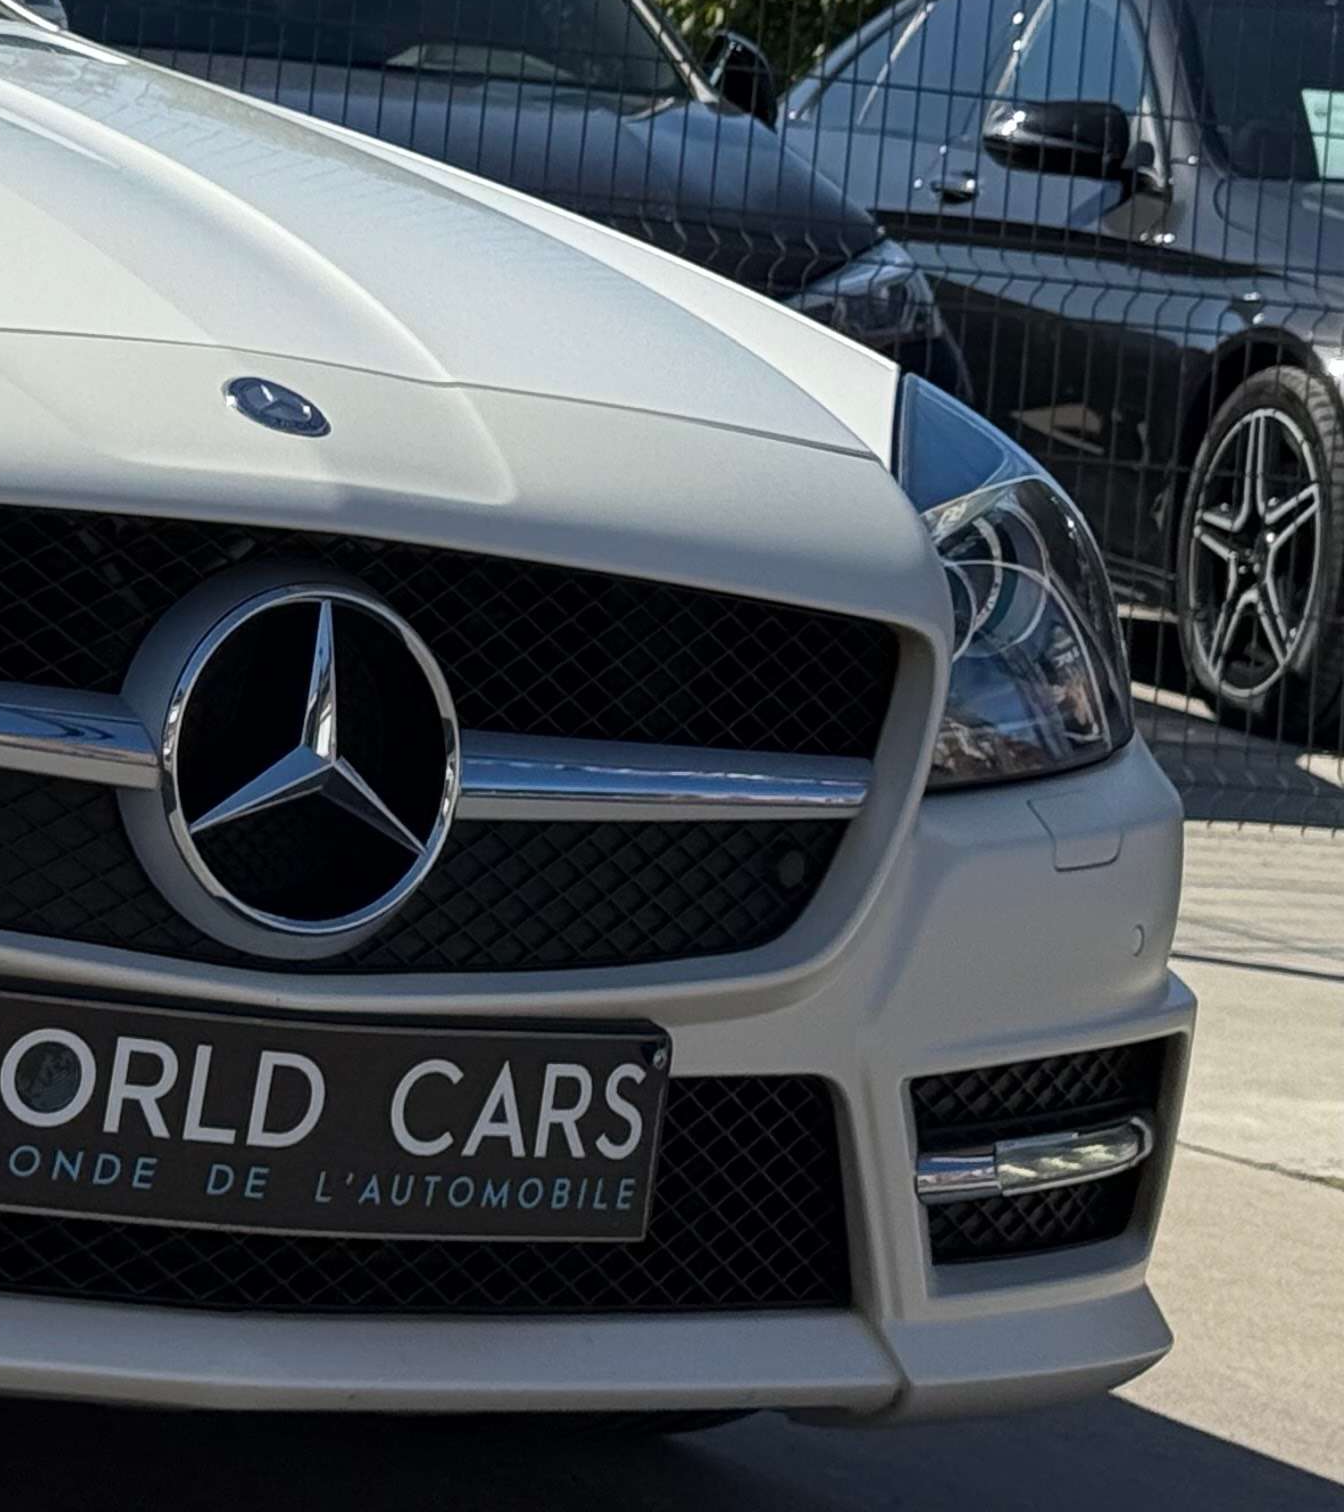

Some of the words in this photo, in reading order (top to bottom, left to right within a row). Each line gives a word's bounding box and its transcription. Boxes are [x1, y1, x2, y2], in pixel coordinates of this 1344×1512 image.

[390, 1058, 647, 1161] CARS
[206, 1163, 270, 1199] DE
[314, 1171, 636, 1210] L'AUTOMOBILE
